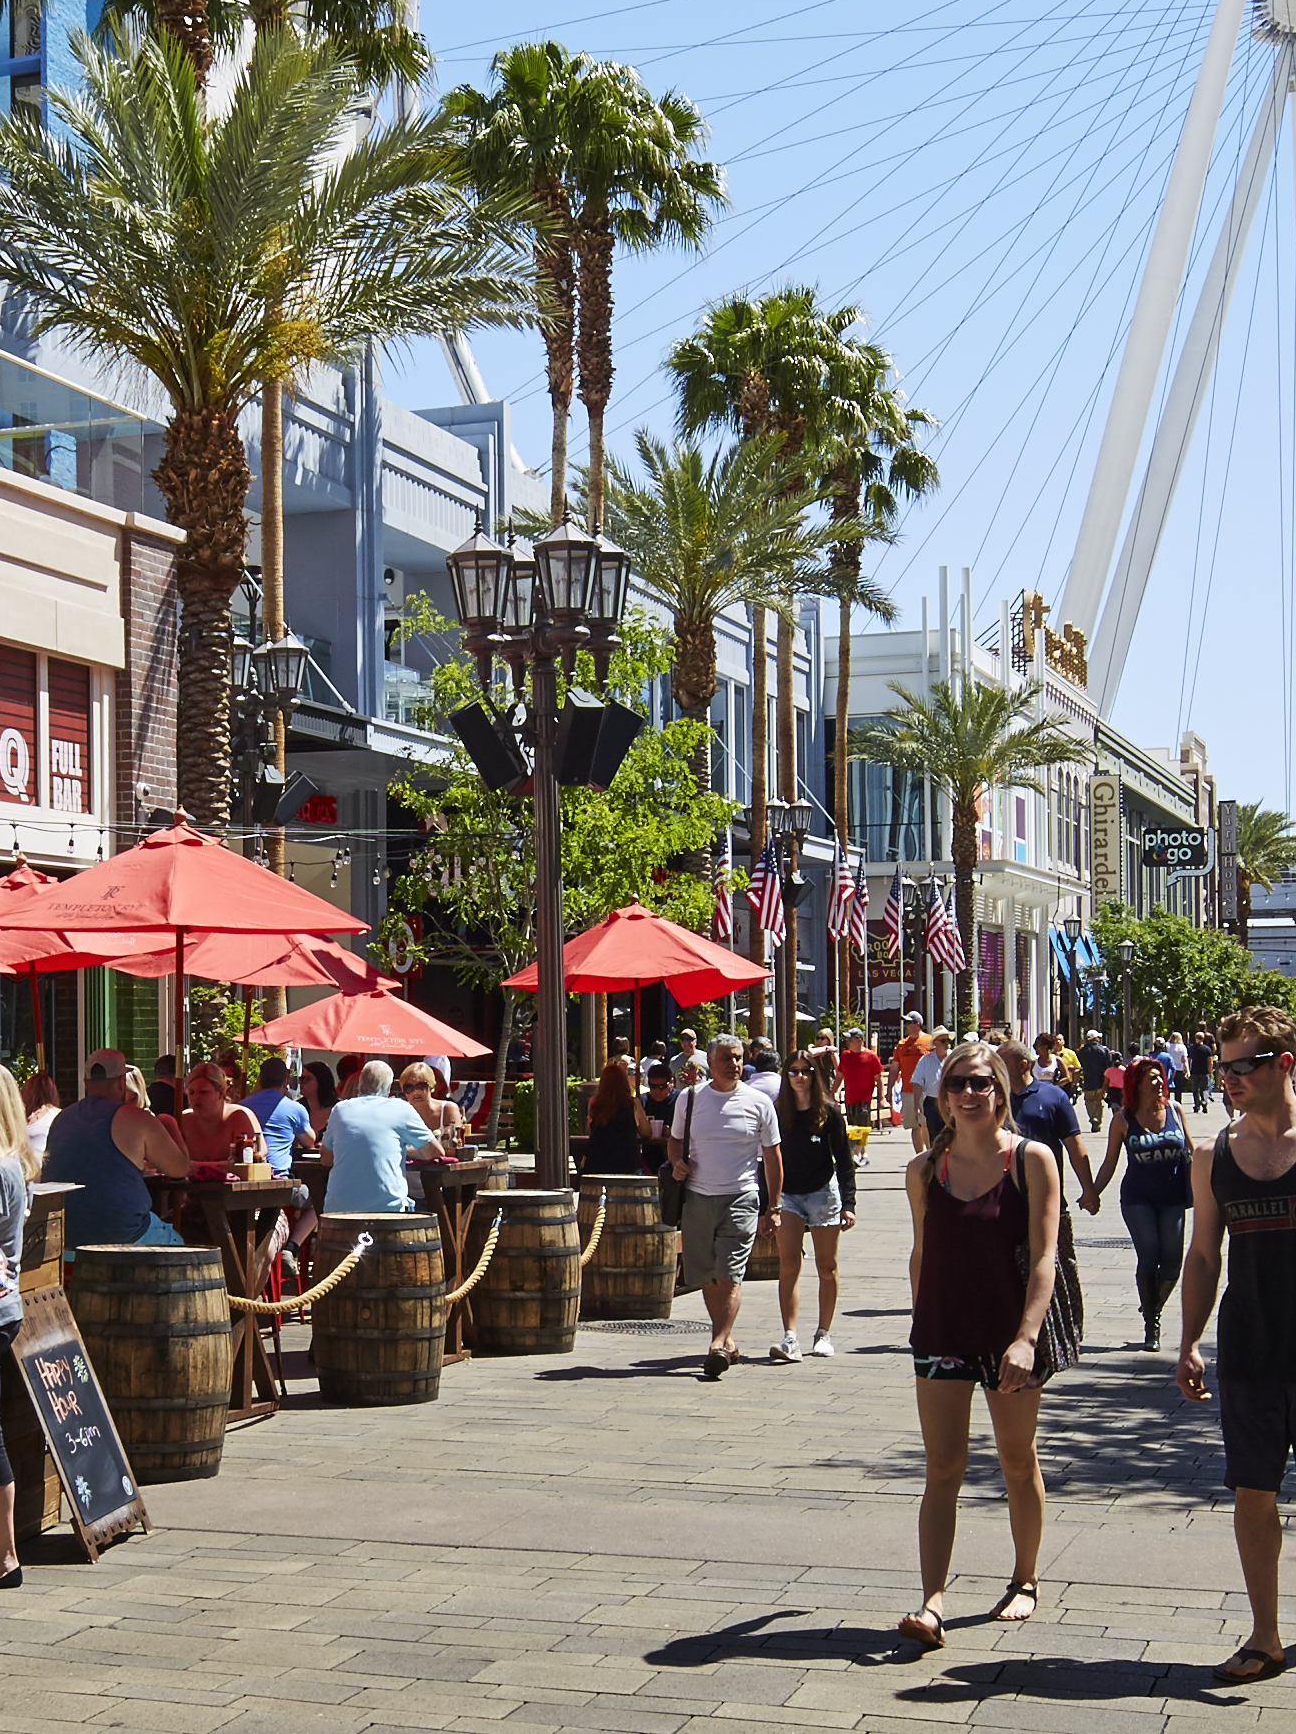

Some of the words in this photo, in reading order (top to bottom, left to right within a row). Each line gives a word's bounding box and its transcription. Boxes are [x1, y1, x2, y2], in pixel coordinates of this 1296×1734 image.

[51, 739, 83, 777] FULL
[52, 777, 83, 813] BAR
[1093, 781, 1117, 906] Ghirardel
[1145, 830, 1202, 851] photo
[1223, 803, 1234, 853] Yard
[883, 970, 915, 978] VEGA
[1128, 1129, 1185, 1148] GUESS
[1229, 1200, 1286, 1219] ARALLEL
[34, 1354, 74, 1390] HAPPY
[46, 1390, 83, 1425] HOUR
[65, 1425, 101, 1454] 3-6pm
